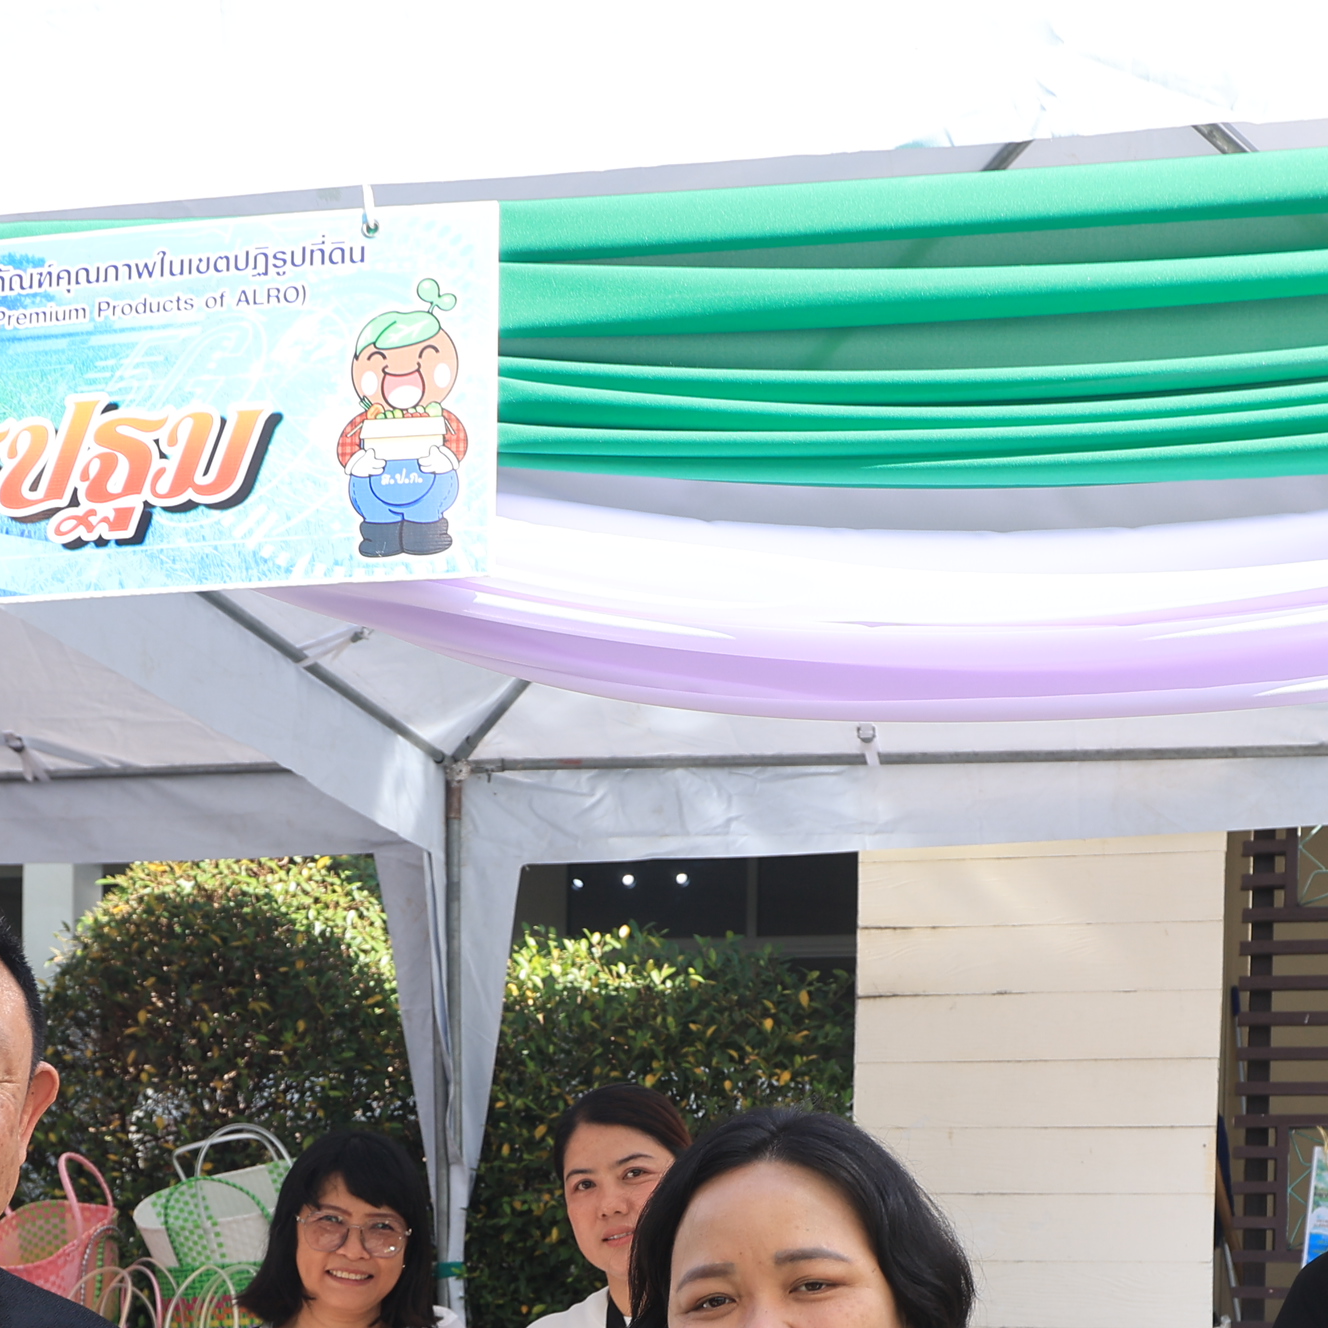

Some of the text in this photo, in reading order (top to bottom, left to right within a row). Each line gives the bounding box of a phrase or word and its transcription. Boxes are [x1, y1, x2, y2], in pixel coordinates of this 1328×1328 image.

[97, 293, 195, 318] Products
[205, 290, 226, 309] of
[235, 283, 308, 307] ALRO)
